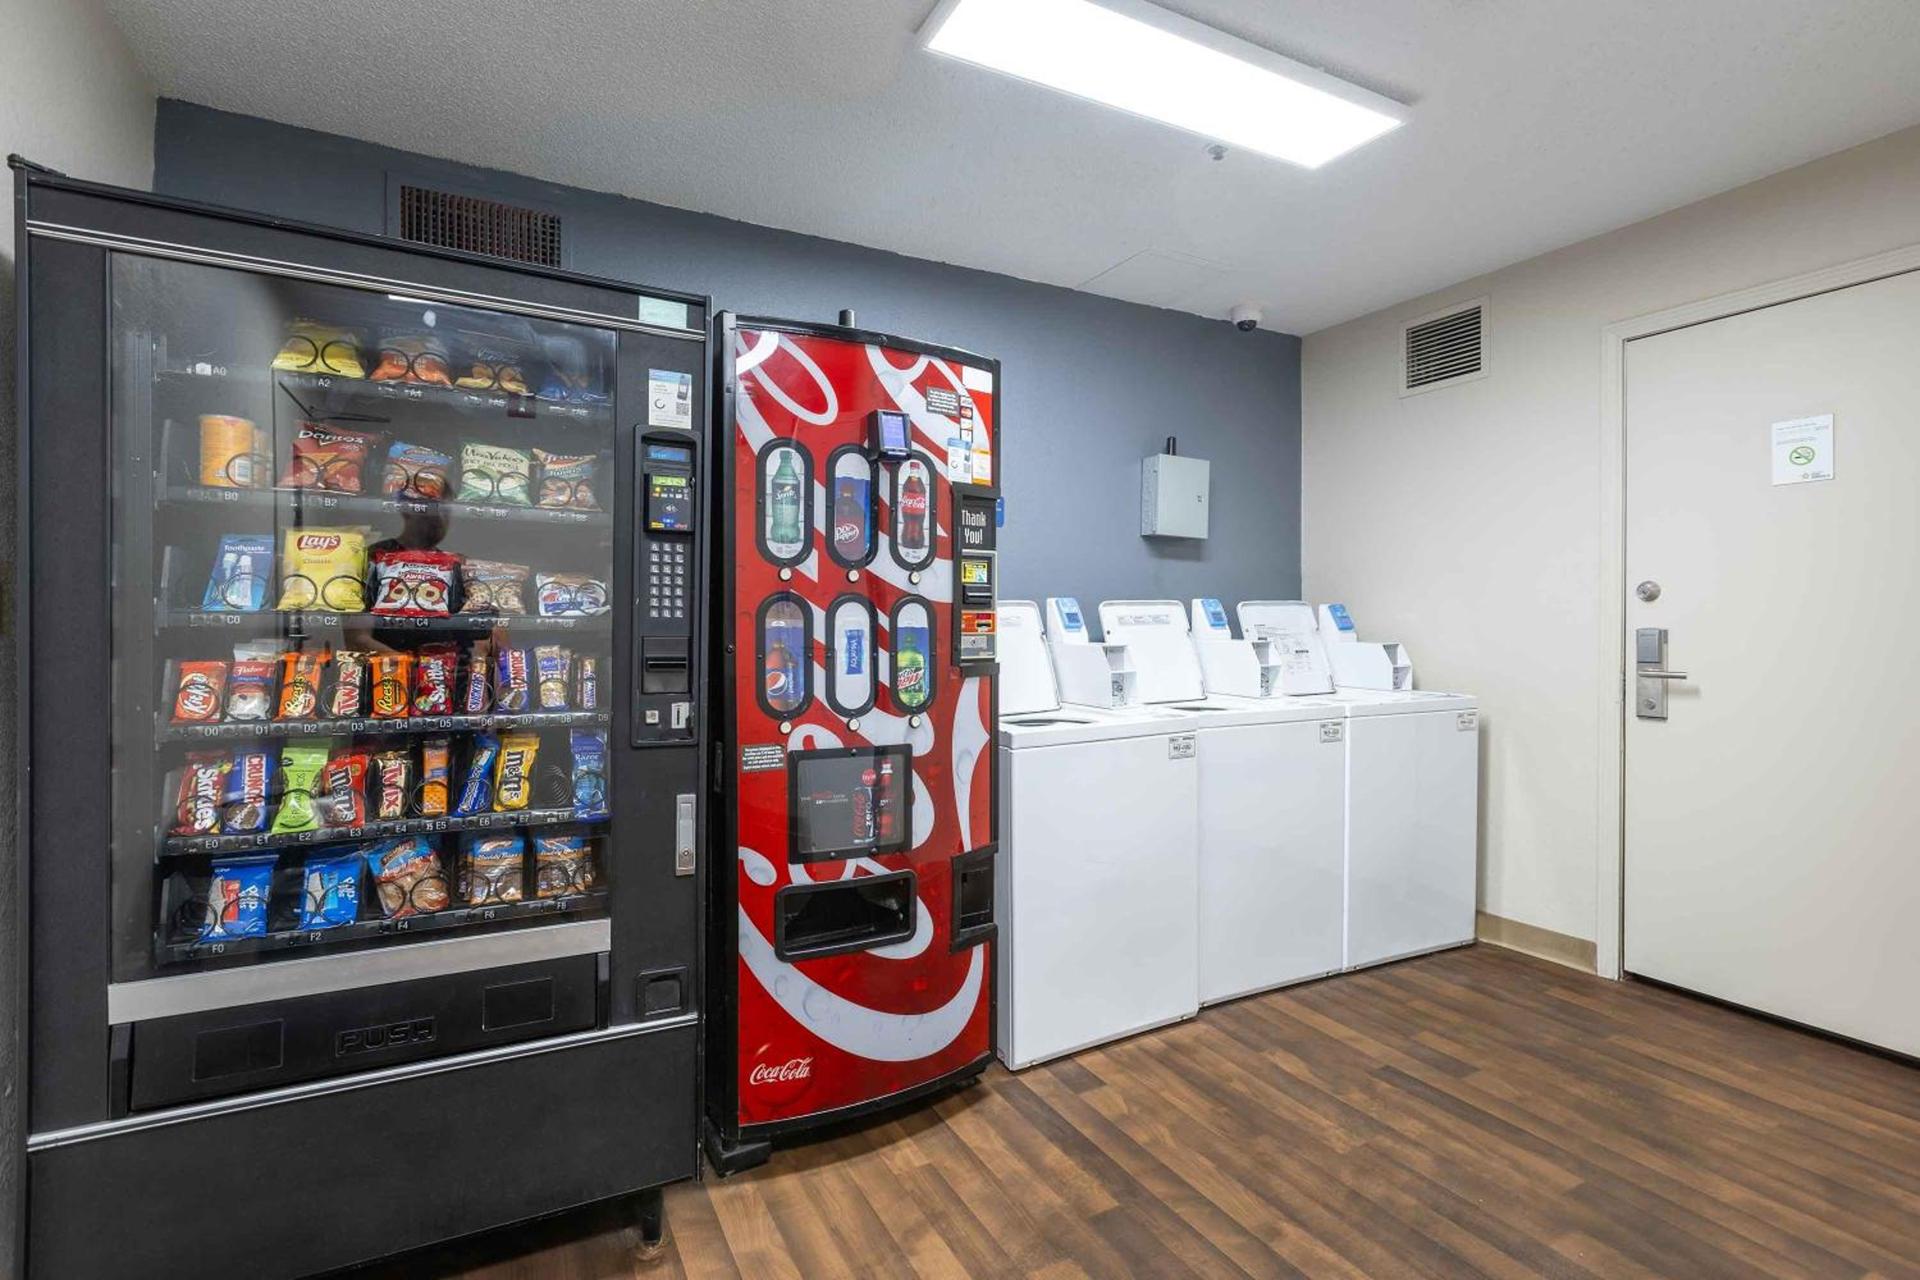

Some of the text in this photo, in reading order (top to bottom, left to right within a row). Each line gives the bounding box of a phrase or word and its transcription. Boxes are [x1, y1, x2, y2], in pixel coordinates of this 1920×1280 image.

[318, 377, 331, 387] A2
[324, 498, 338, 508] B2
[961, 509, 987, 527] Thank
[964, 528, 983, 545] You!
[299, 535, 339, 550] Lay's
[227, 615, 241, 625] C0
[324, 617, 337, 626] C2
[416, 618, 428, 627] C4
[510, 650, 526, 688] CRUNCH
[377, 673, 393, 713] Reese's
[481, 717, 492, 727] D6
[598, 713, 608, 721] D9
[304, 724, 317, 733] D2
[352, 722, 364, 731] D3
[396, 720, 408, 729] D4
[440, 719, 452, 728] D5
[255, 725, 269, 735] D1
[246, 755, 265, 806] CRUNCH
[195, 767, 219, 830] Skittles
[865, 801, 873, 826] zero
[479, 818, 490, 826] E6
[520, 815, 530, 823] E7
[395, 825, 407, 833] E4
[436, 821, 447, 830] E5
[299, 832, 311, 841] E2
[350, 828, 362, 837] E3
[205, 839, 219, 849] E0
[256, 834, 269, 845] E1
[484, 910, 495, 919] F6
[397, 920, 409, 930] F4
[310, 932, 322, 941] F2
[212, 943, 225, 953] F0
[340, 1019, 434, 1055] PUSH
[749, 1057, 814, 1085] Coca-Cola
